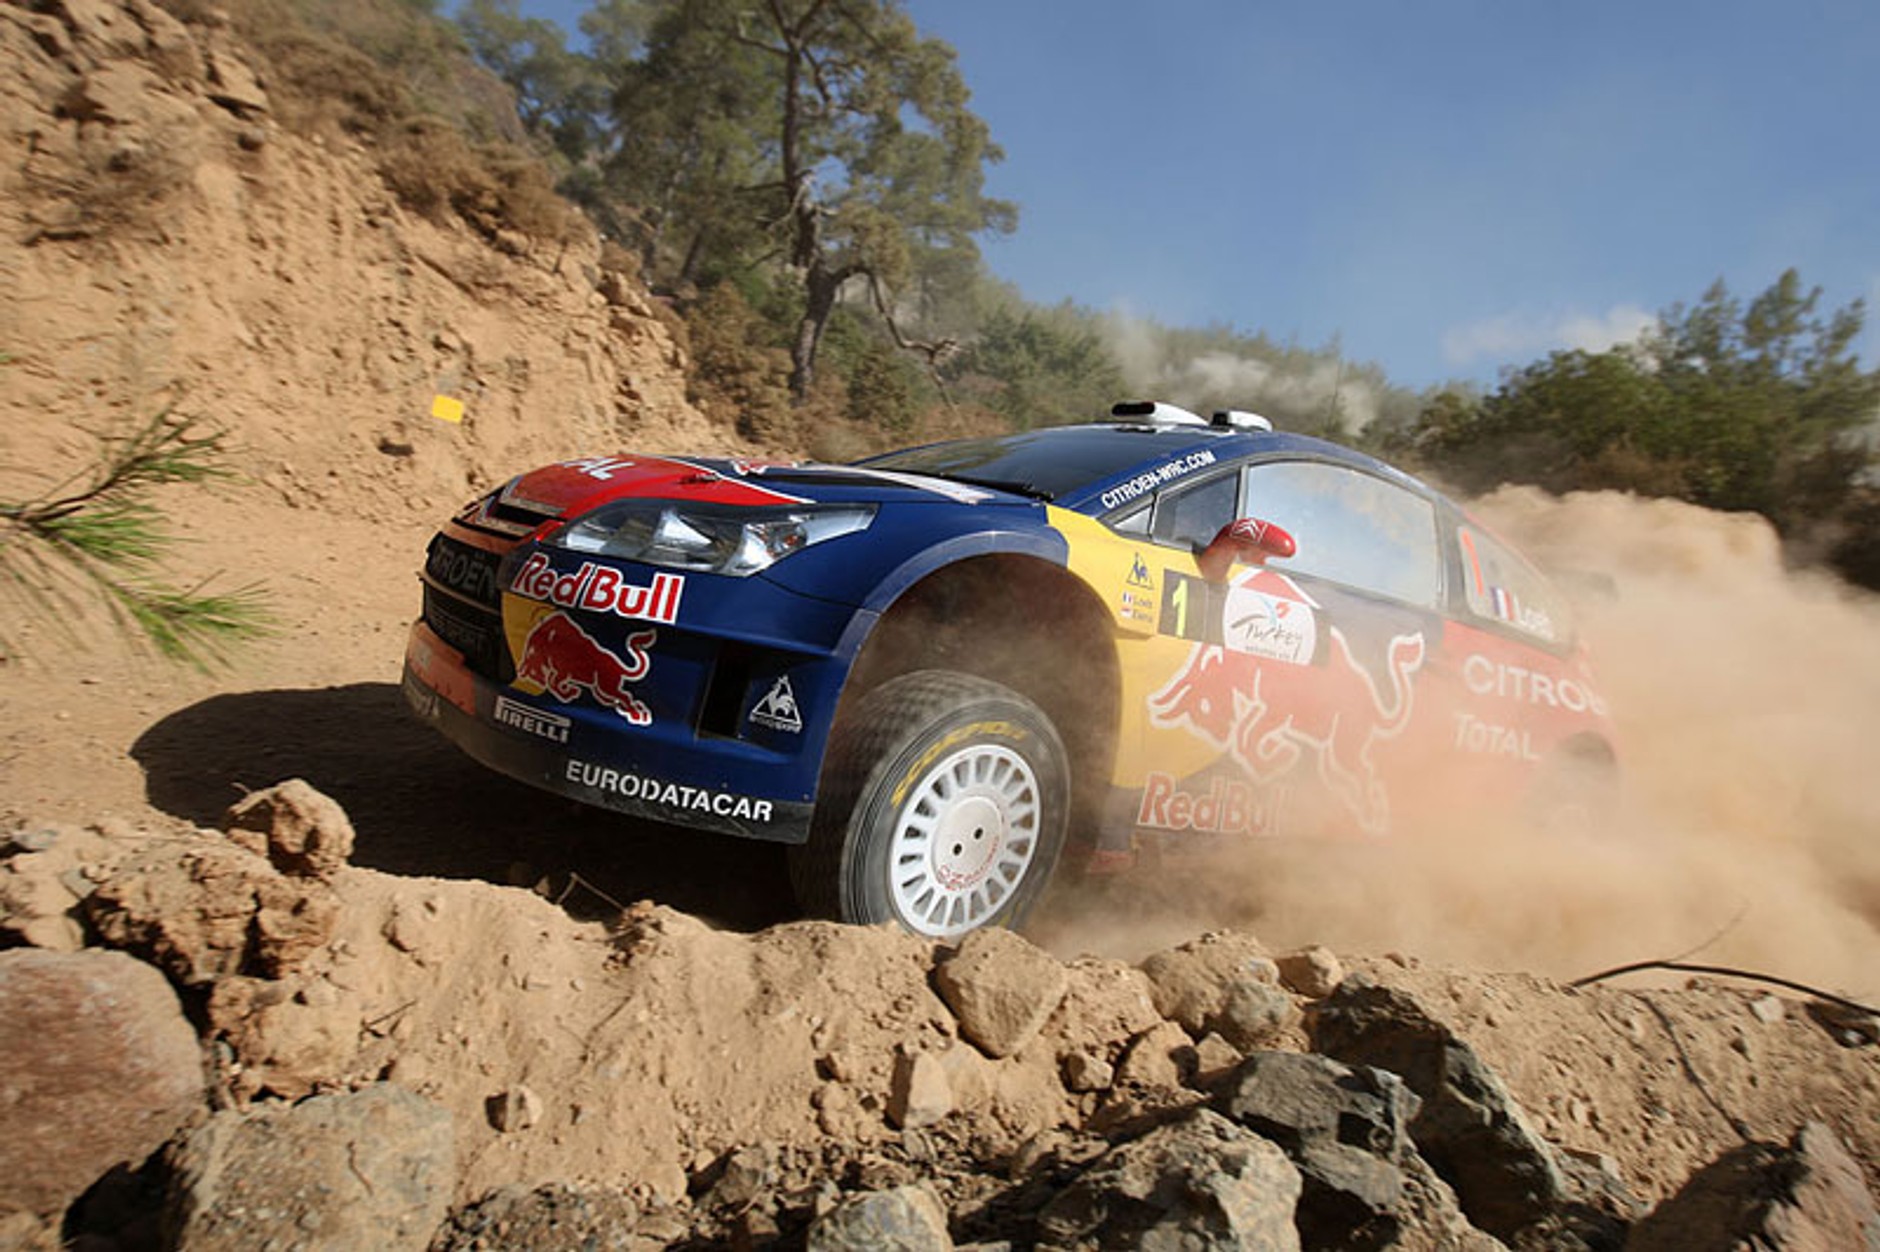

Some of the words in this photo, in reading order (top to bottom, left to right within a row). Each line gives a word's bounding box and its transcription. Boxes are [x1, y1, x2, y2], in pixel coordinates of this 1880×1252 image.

[1101, 449, 1217, 509] CITROEN-WRC.COM
[511, 552, 595, 608] Red
[580, 566, 685, 625] Bull
[1172, 578, 1188, 638] 1
[494, 695, 571, 743] PIRELLI
[565, 759, 774, 822] EURODATACAR
